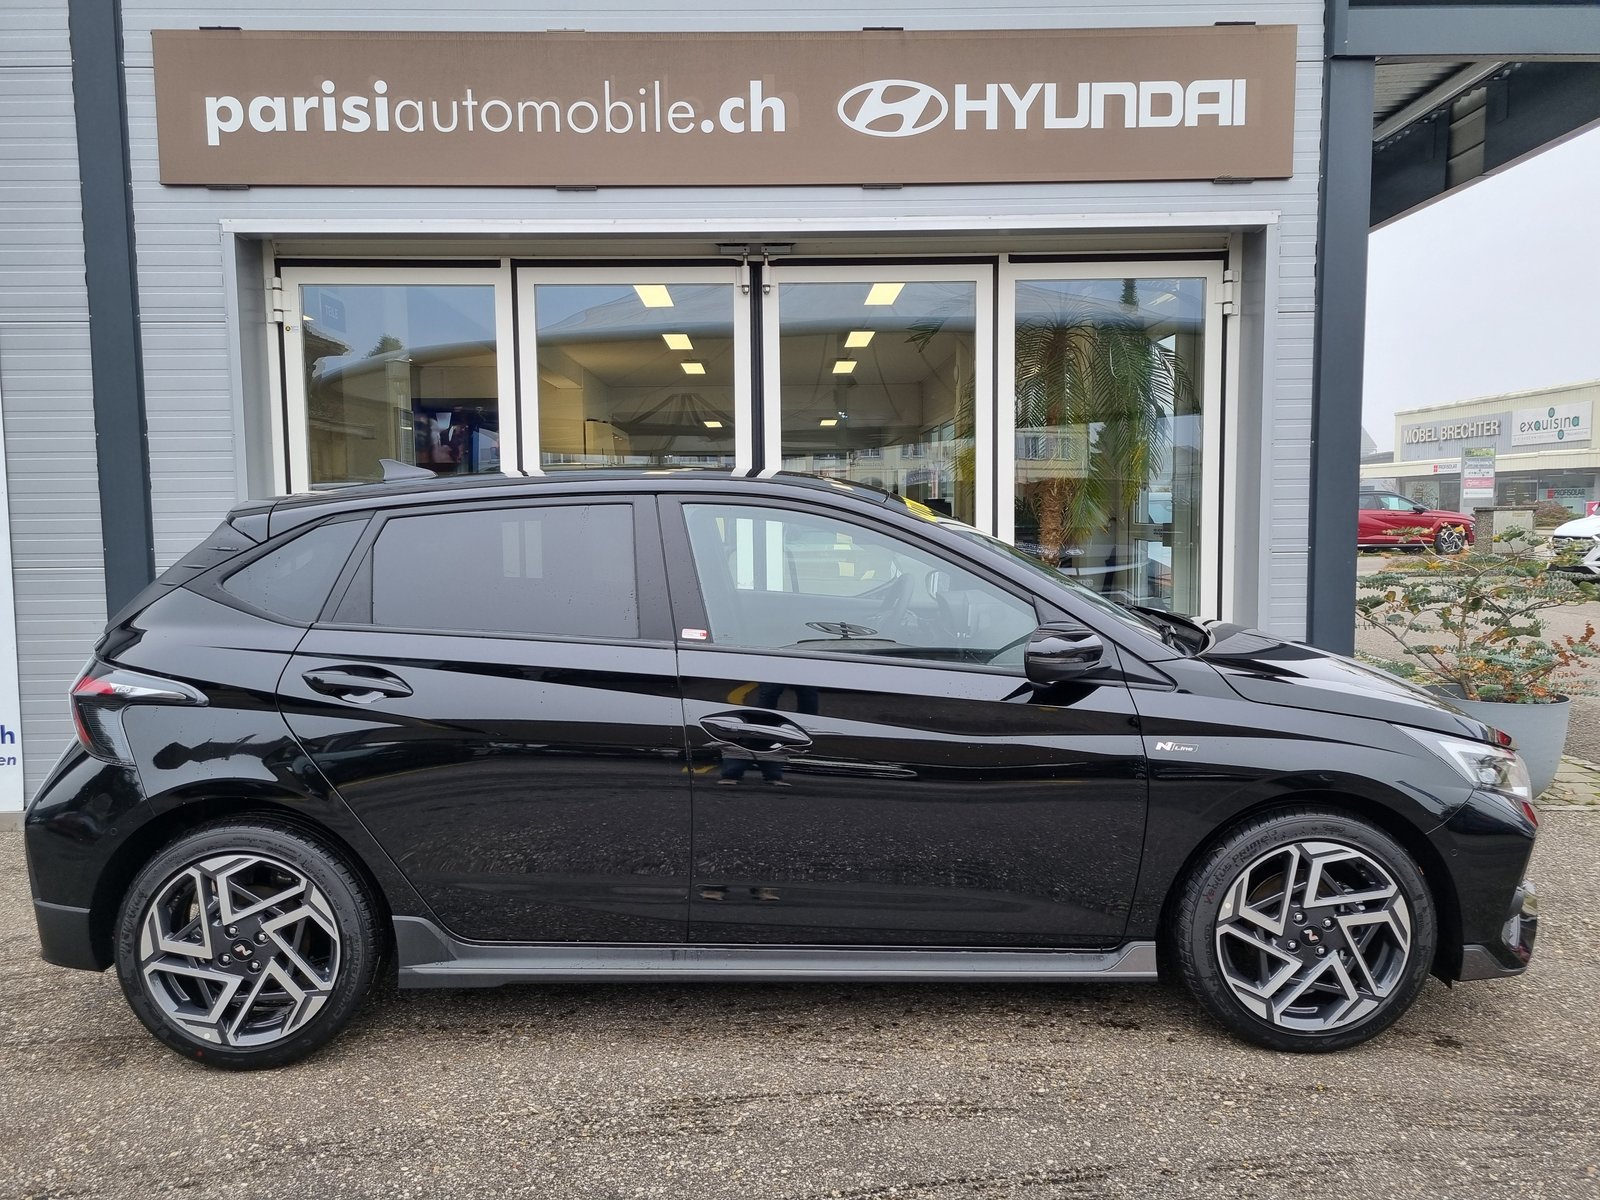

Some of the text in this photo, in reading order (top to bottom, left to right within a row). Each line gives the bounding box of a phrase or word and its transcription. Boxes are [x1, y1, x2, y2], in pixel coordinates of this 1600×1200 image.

[205, 79, 786, 146] parisiautomobile.ch
[954, 78, 1247, 130] HYUNDAI
[1404, 426, 1438, 444] MÖBEL
[1440, 420, 1500, 440] BRECHTER
[1520, 408, 1580, 433] exquisina
[1155, 741, 1173, 751] N
